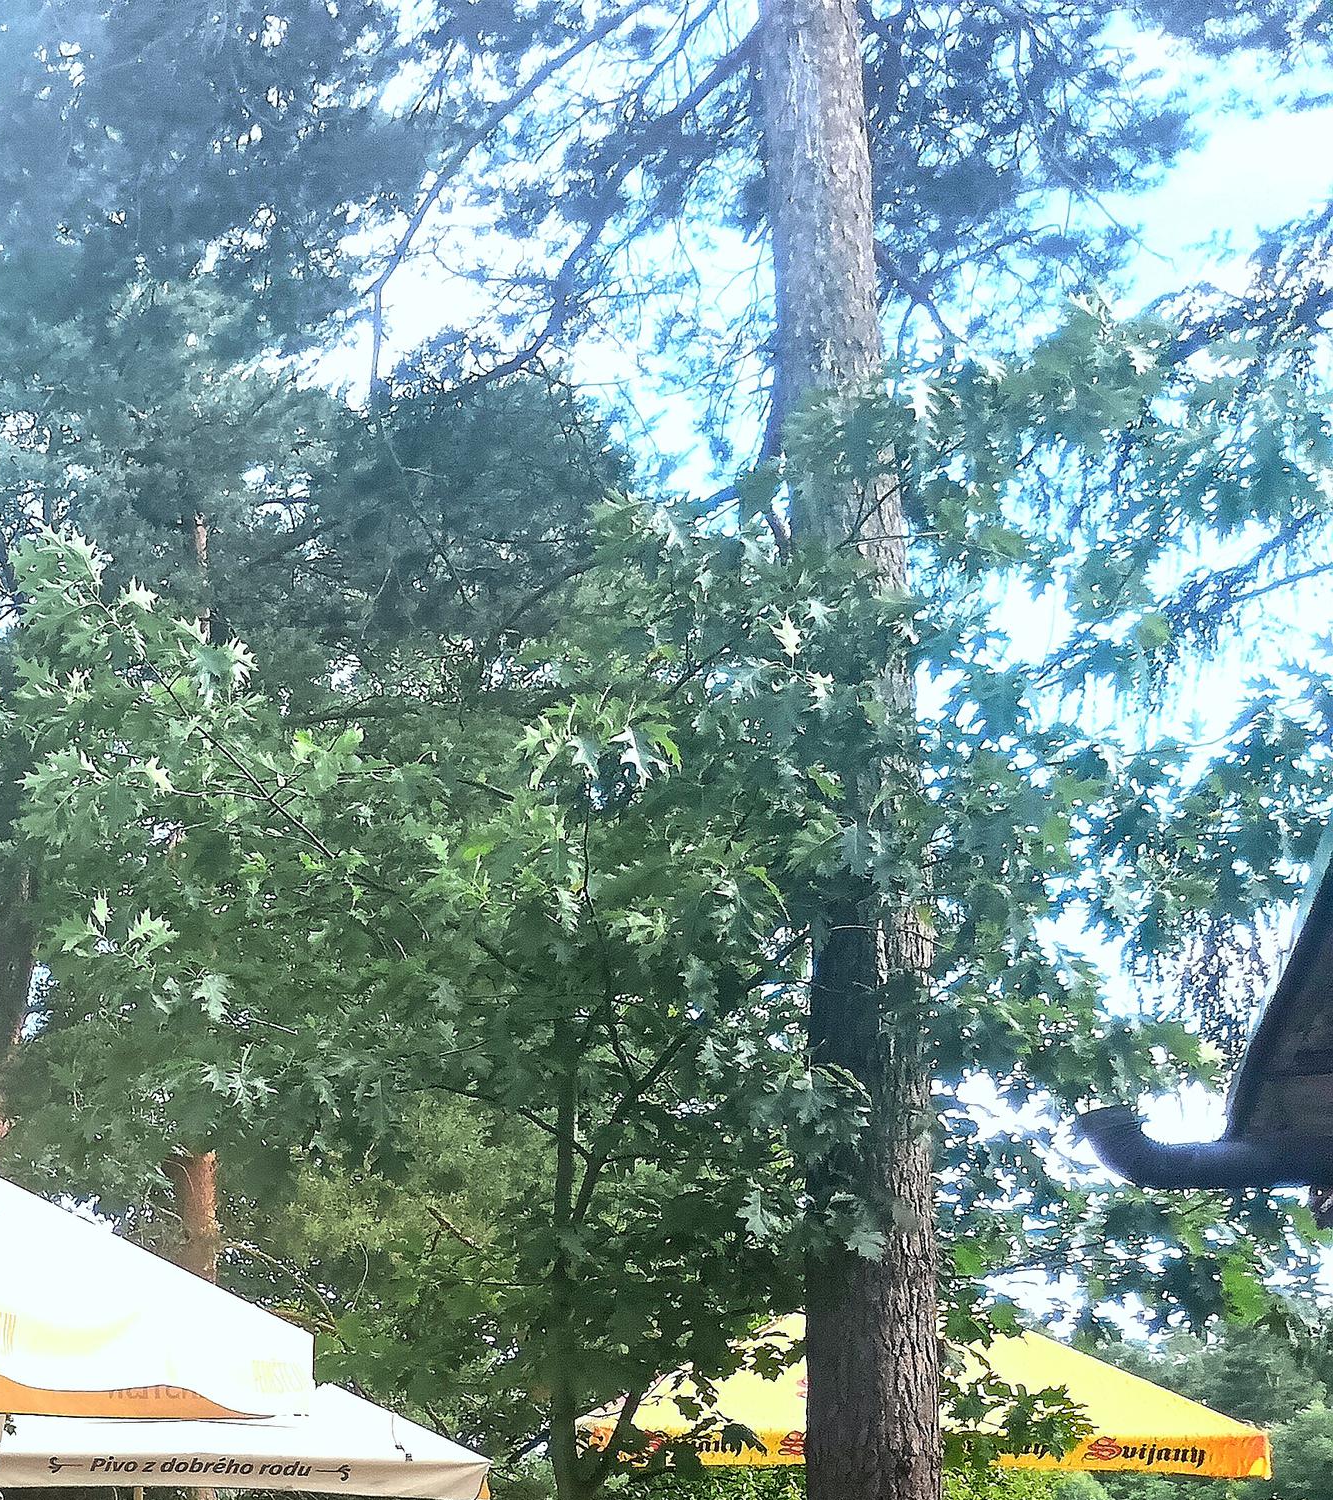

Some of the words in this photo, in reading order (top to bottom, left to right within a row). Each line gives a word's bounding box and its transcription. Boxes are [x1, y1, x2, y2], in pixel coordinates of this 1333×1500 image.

[1082, 1436, 1206, 1467] Svijany
[89, 1455, 138, 1473] Pivo
[141, 1461, 155, 1473] z
[160, 1457, 254, 1476] dobrého
[259, 1460, 312, 1477] rodu
